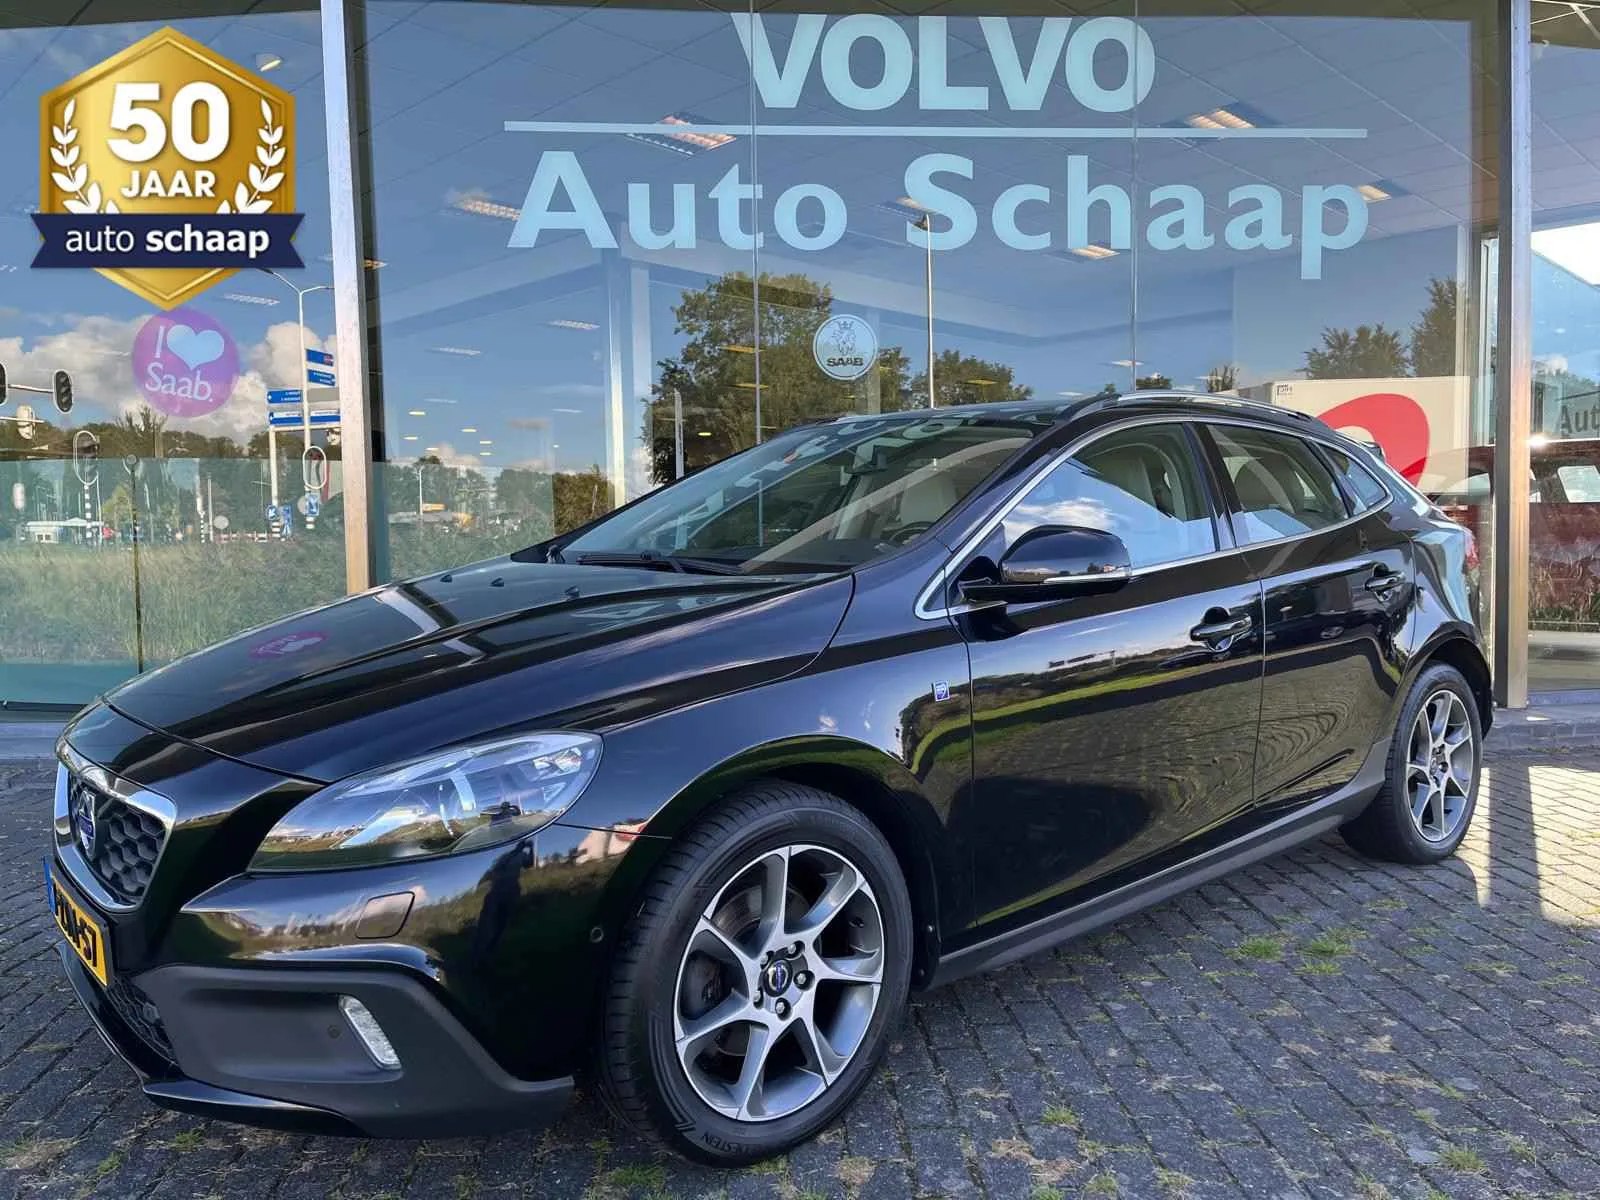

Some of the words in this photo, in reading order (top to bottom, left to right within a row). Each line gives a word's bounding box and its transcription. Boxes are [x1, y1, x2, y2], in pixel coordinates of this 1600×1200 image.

[732, 13, 1155, 113] VOLVO
[507, 150, 848, 252] Auto
[904, 153, 1369, 281] Schaap
[826, 357, 865, 367] SAAB
